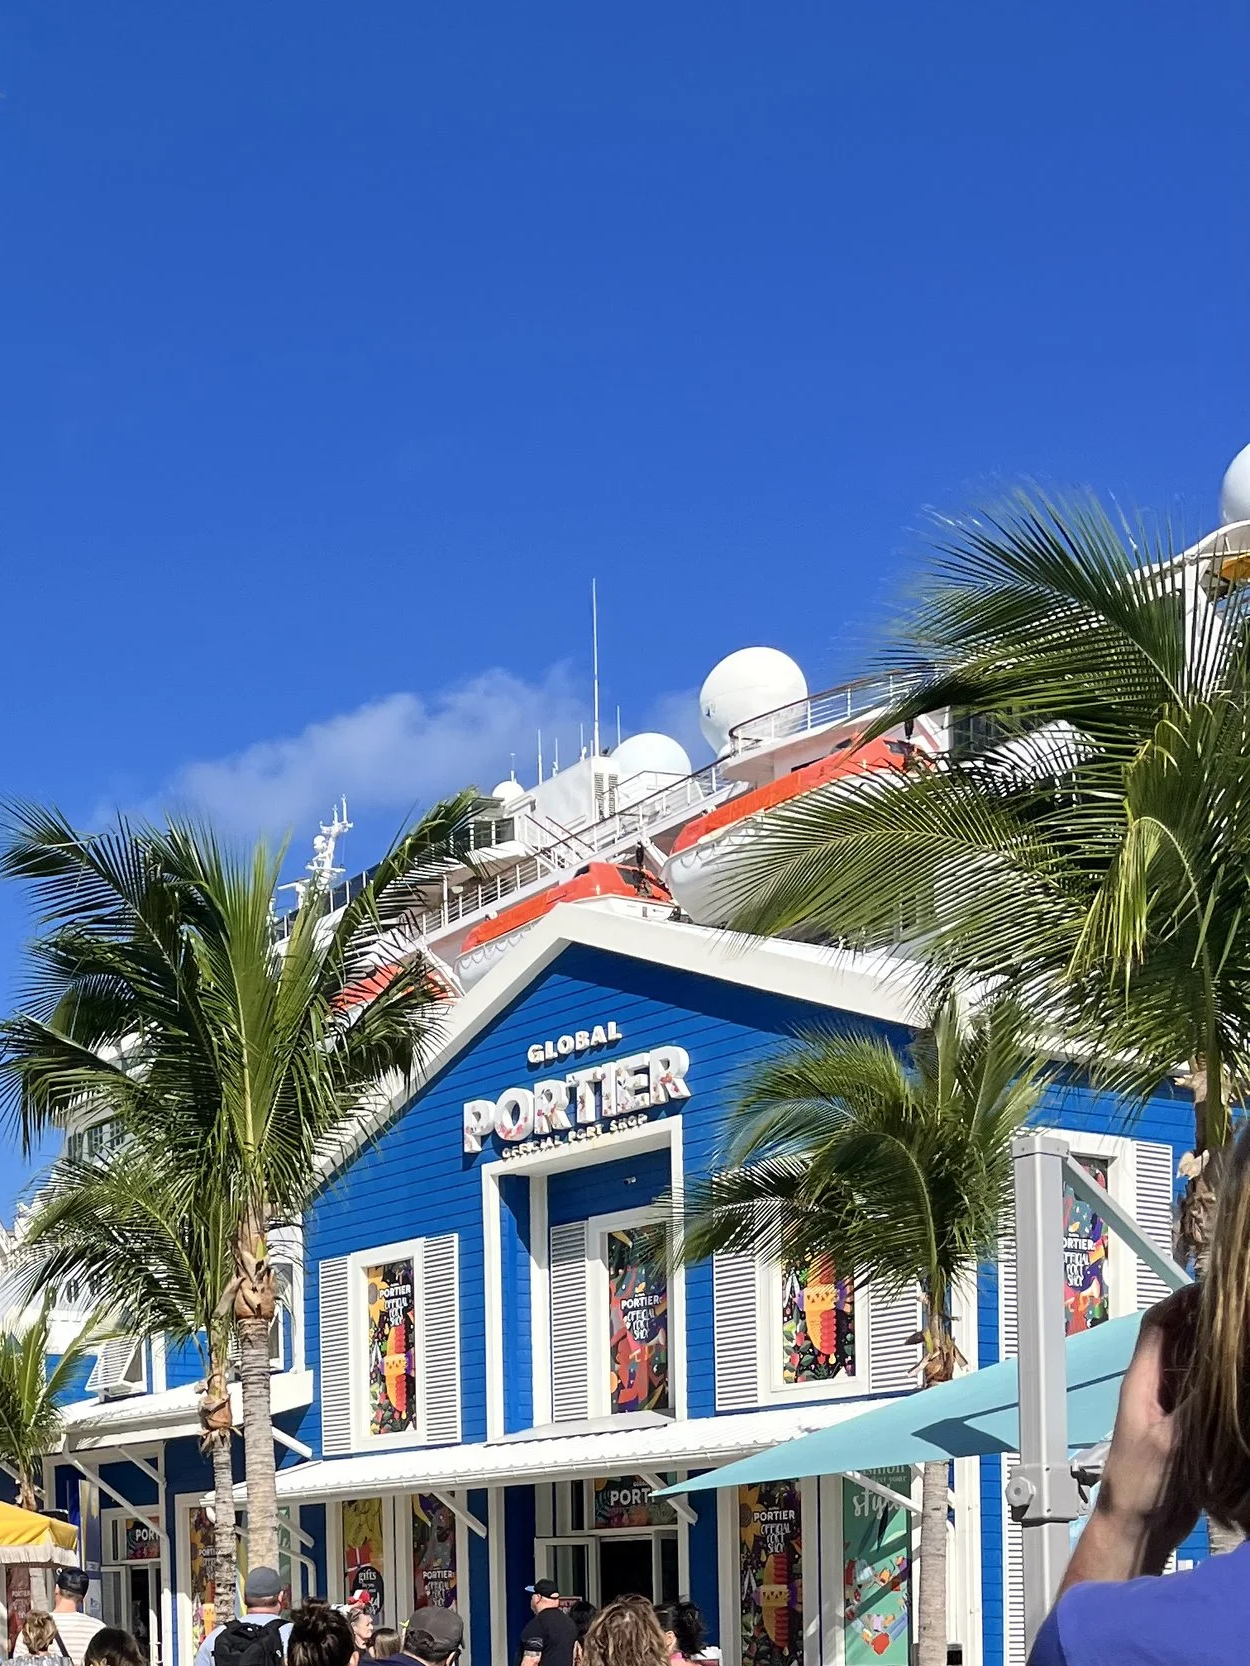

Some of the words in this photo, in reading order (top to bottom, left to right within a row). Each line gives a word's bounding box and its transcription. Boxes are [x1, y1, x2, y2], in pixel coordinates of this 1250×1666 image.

[527, 1021, 622, 1063] GLOBAL
[463, 1045, 692, 1153] PORTIER
[567, 1124, 604, 1142] PORT
[609, 1113, 648, 1132] SHOP
[1063, 1237, 1095, 1250] ORTIER
[379, 1284, 411, 1299] PORTIER
[621, 1295, 659, 1310] PORTIER
[610, 1488, 655, 1506] PORT
[753, 1510, 795, 1522] PORTIER
[358, 1569, 377, 1584] gifts
[422, 1570, 453, 1580] PORTIER
